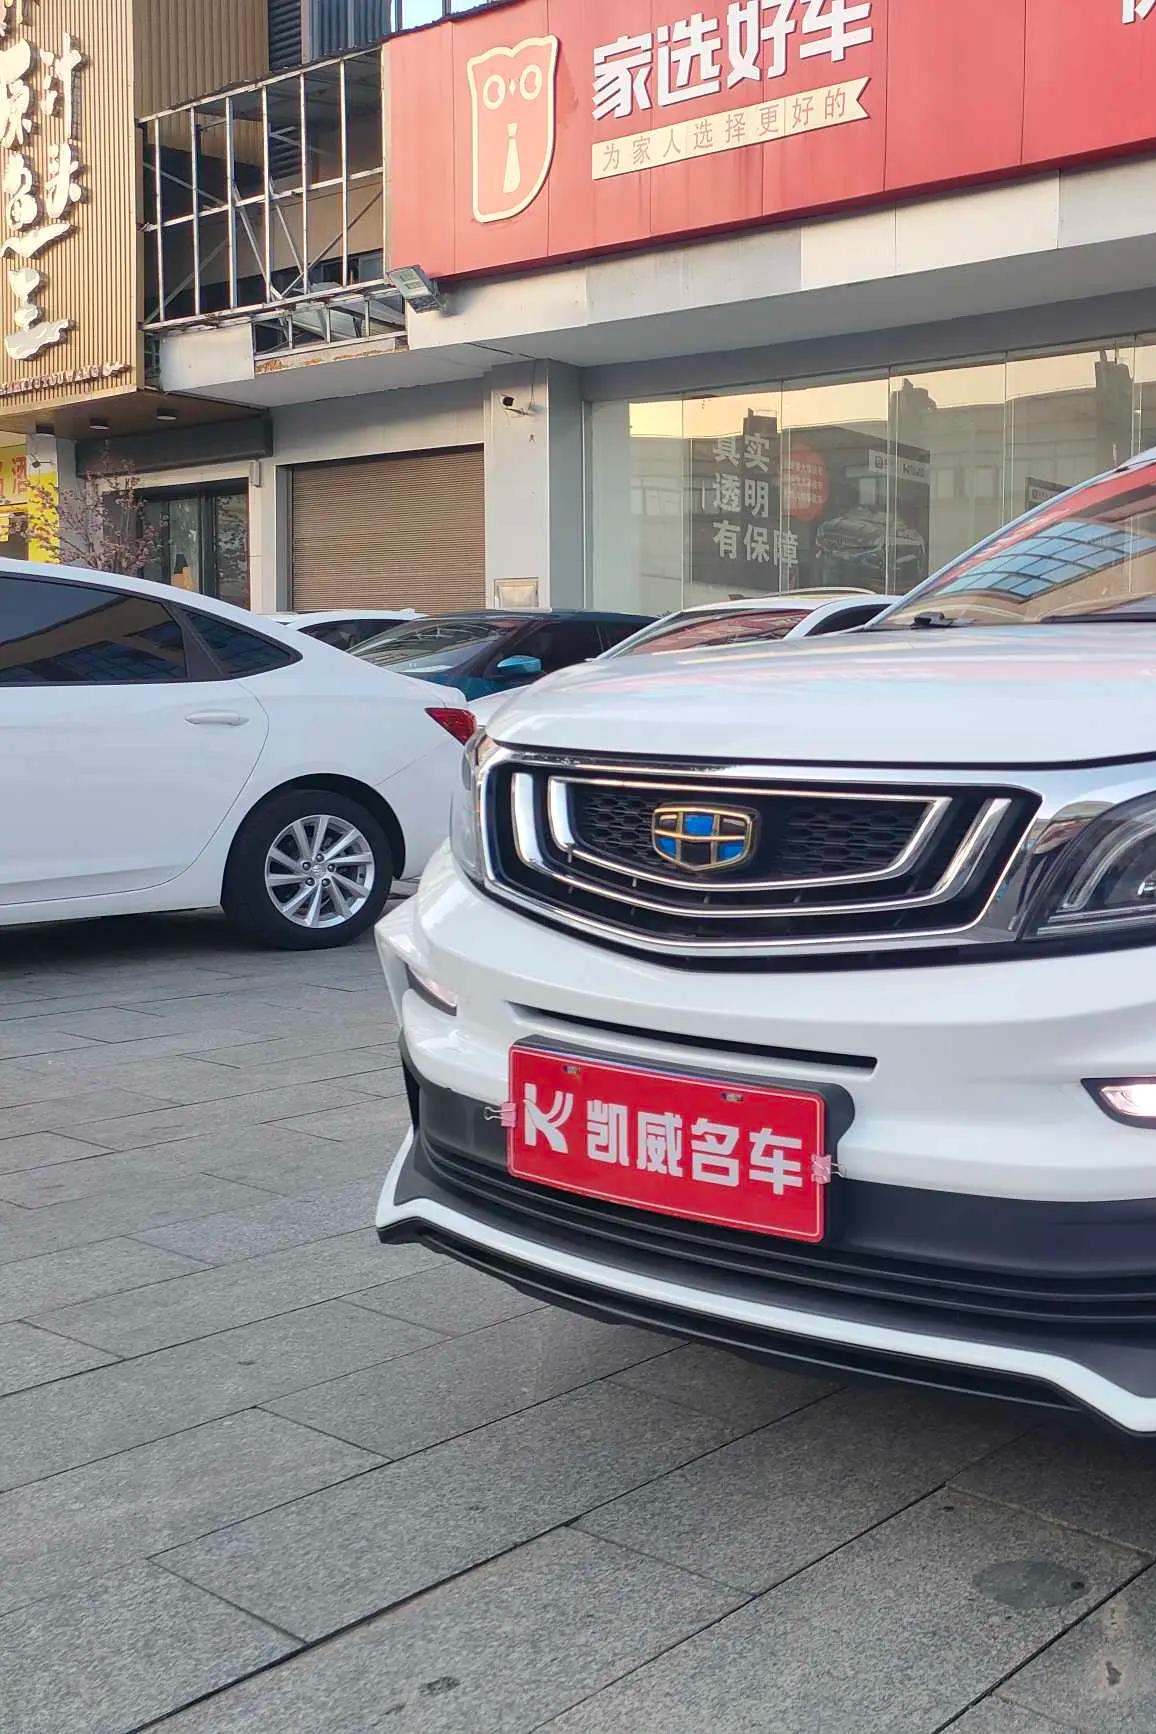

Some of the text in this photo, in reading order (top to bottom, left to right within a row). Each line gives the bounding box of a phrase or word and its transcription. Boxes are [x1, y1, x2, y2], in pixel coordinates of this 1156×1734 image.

[591, 0, 874, 121] 家选好车
[602, 89, 847, 173] 为家人选择更好的
[713, 472, 769, 518] 透明
[712, 519, 800, 569] 有保障
[585, 1099, 803, 1195] 凯威名车
